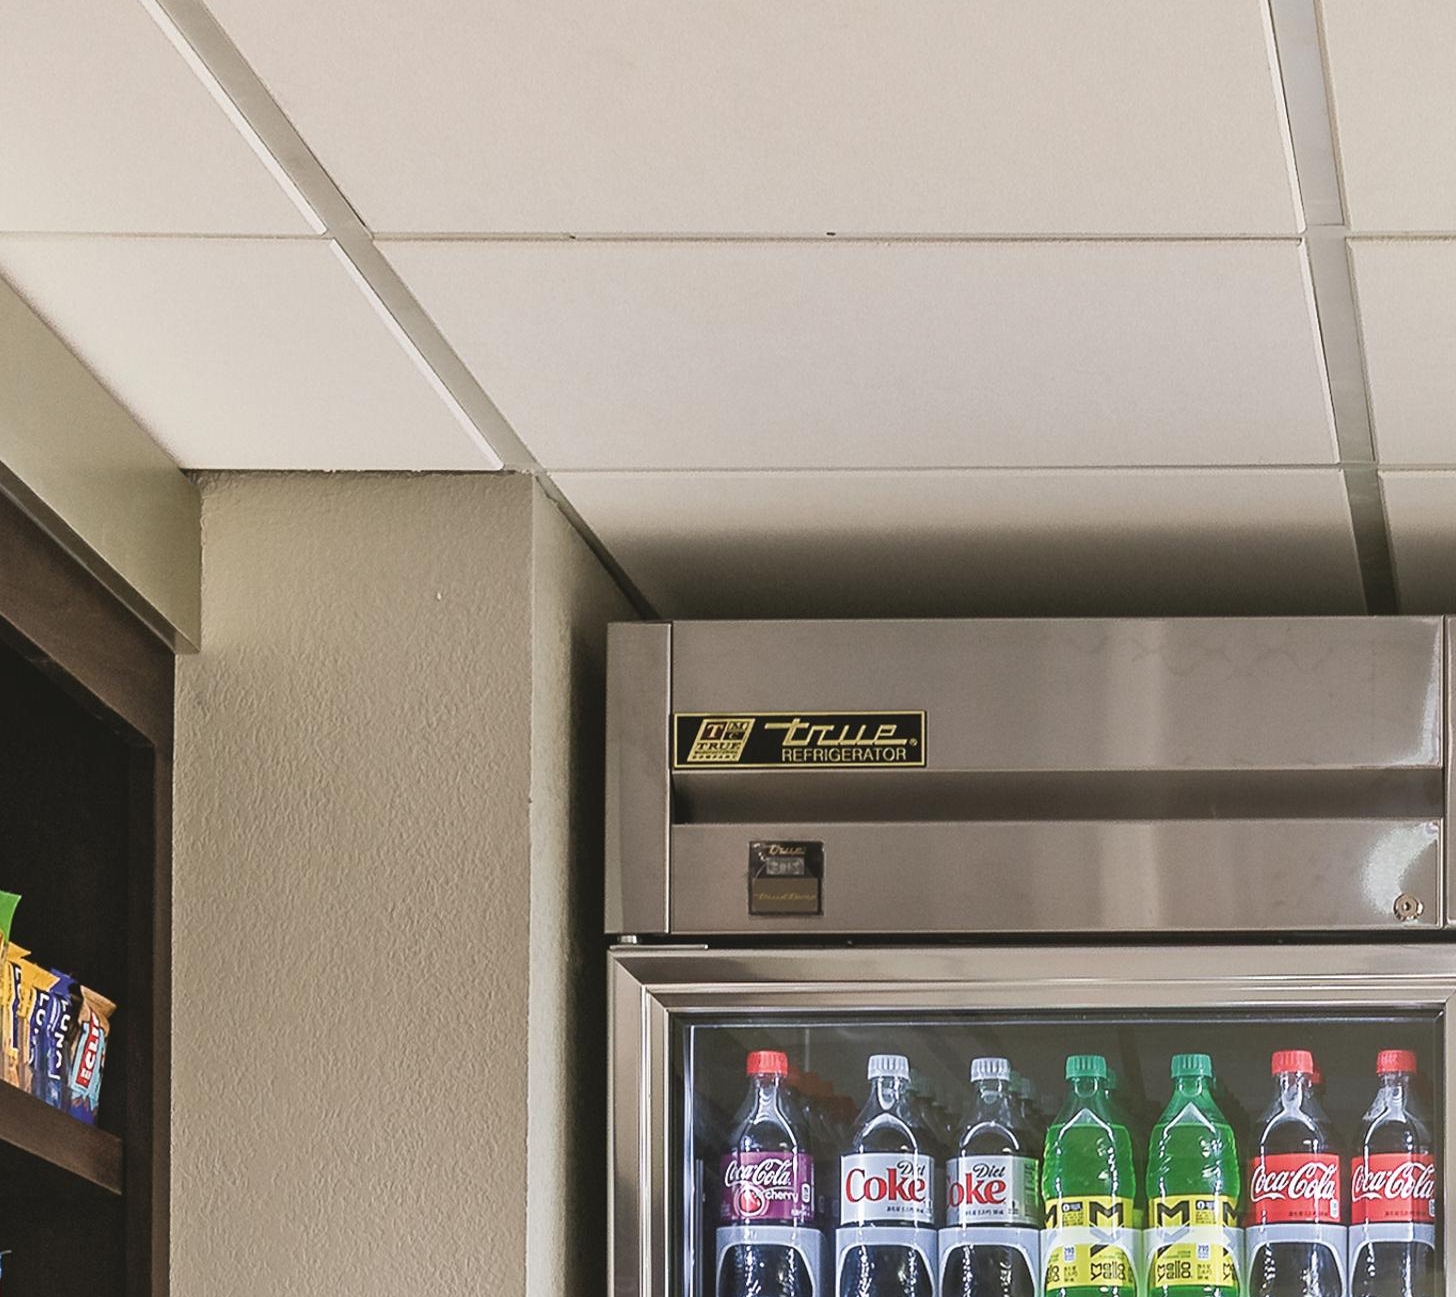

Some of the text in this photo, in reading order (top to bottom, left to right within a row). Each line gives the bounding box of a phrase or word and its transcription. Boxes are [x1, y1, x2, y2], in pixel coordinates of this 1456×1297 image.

[764, 718, 908, 746] true
[782, 748, 906, 762] REFRIGERATOR
[846, 1167, 926, 1203] Coke
[972, 1162, 1006, 1179] Diet
[1251, 1162, 1337, 1201] Coca-Cola
[1352, 1162, 1435, 1201] Coca-Cola
